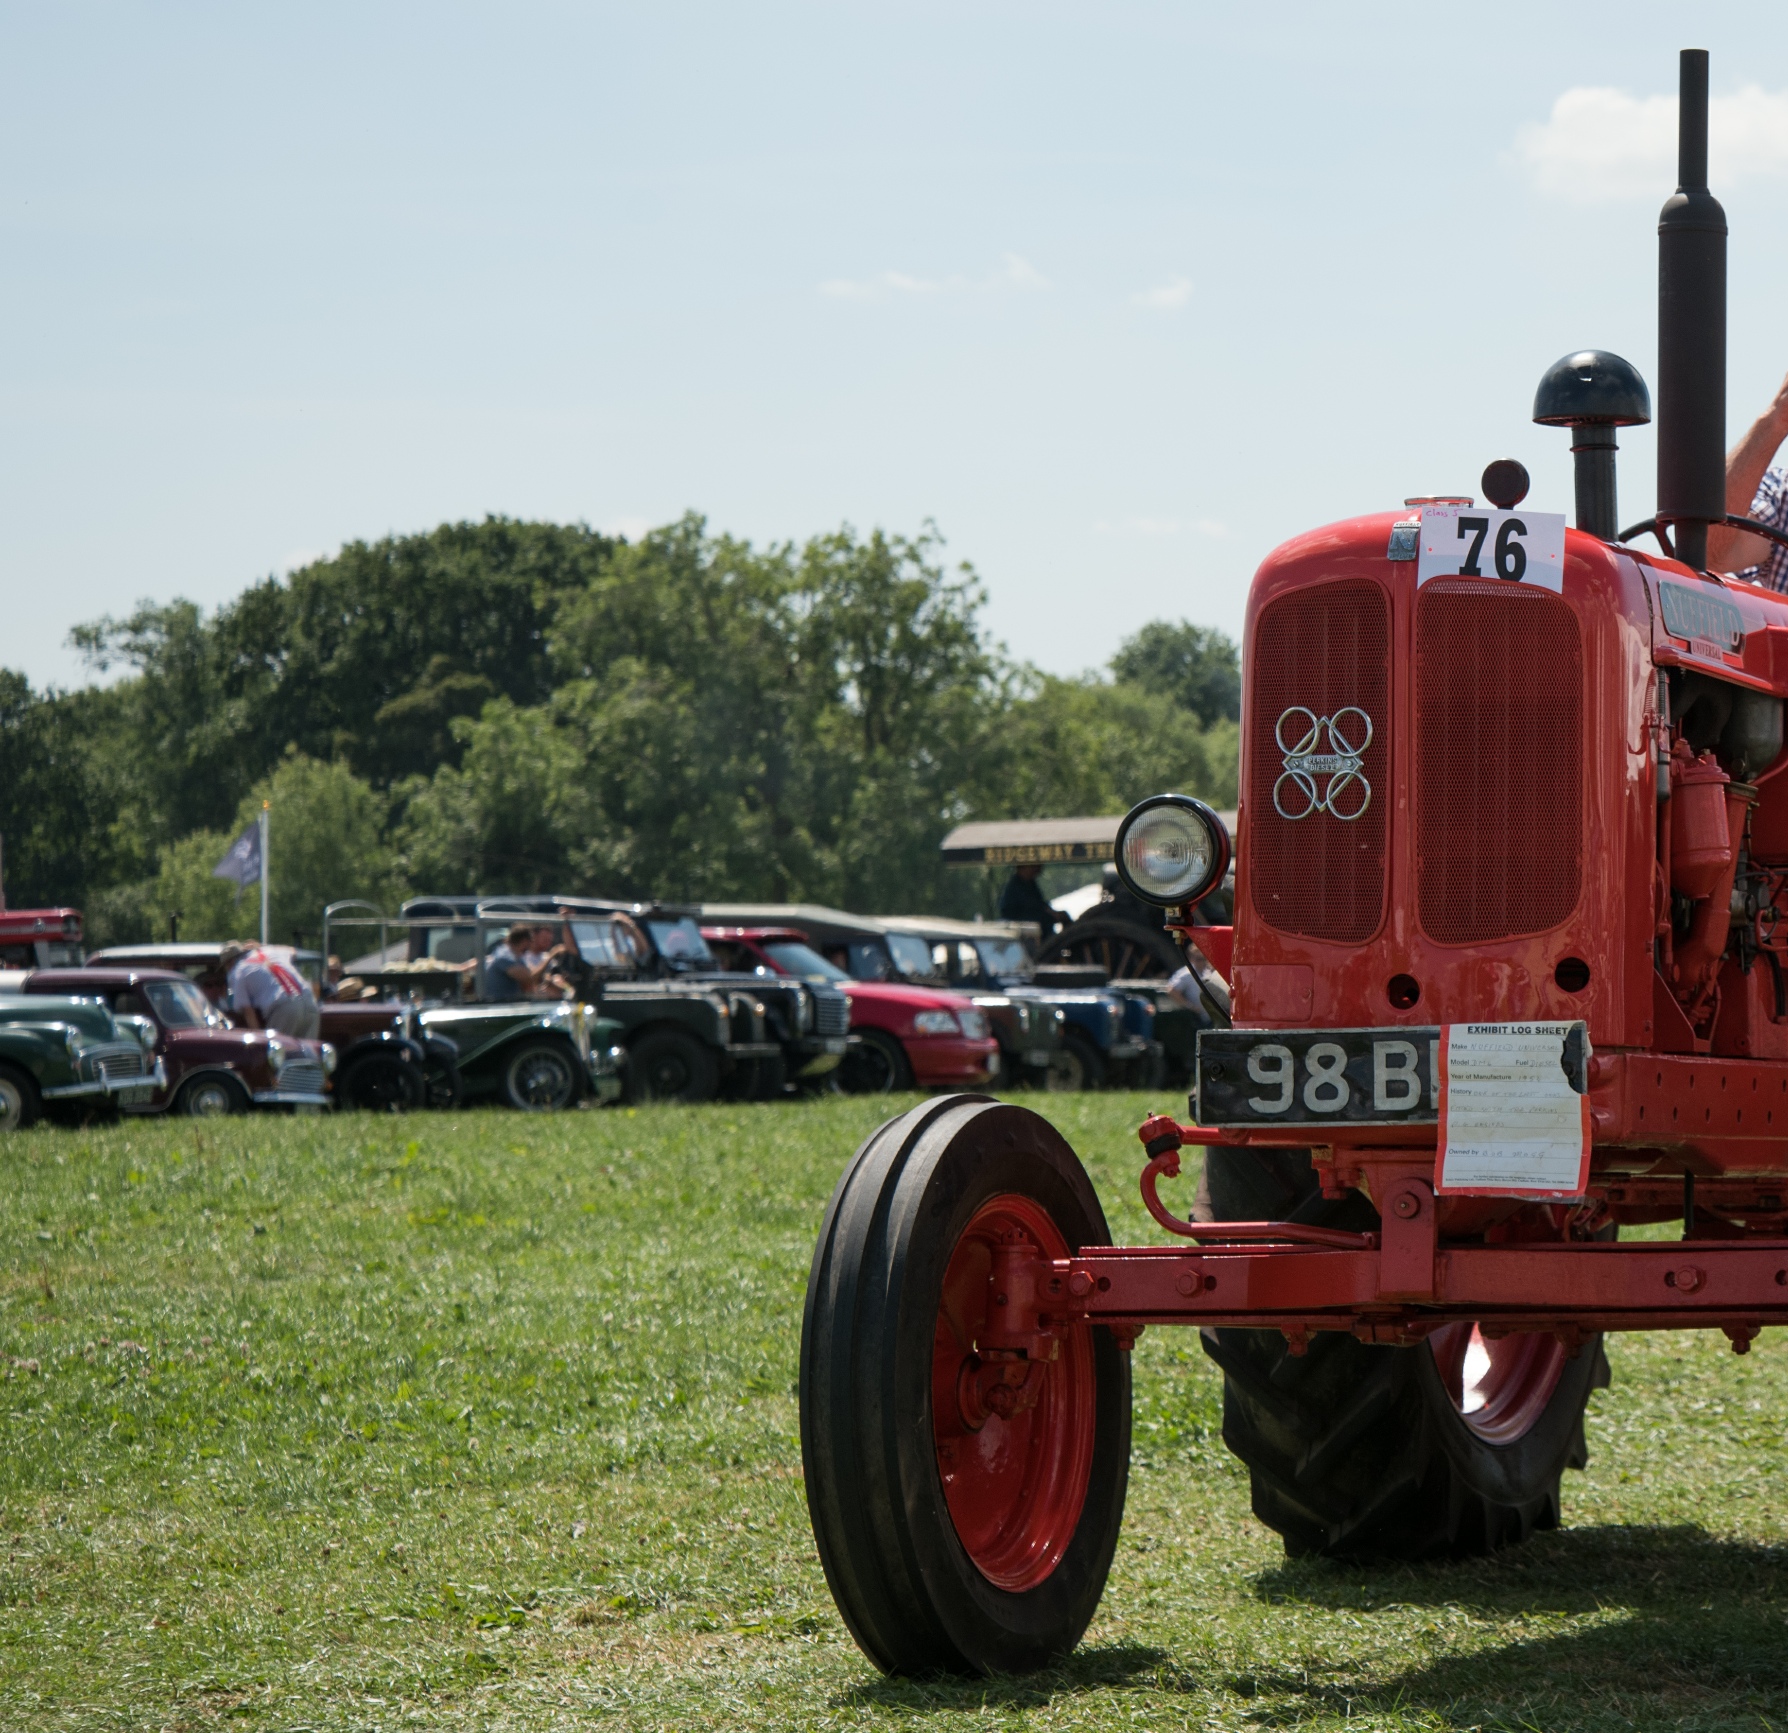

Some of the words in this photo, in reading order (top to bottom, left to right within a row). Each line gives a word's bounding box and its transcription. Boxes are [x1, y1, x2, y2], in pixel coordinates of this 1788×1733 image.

[1425, 509, 1448, 517] Class
[1452, 508, 1463, 517] 5
[1457, 516, 1528, 583] 76
[1665, 585, 1740, 647] NUFFIELD
[1692, 640, 1721, 660] UNIVERSAL
[985, 845, 1074, 863] RIDGEWAY
[1467, 1025, 1508, 1035] EXHIBIT
[1511, 1026, 1532, 1035] LOG
[1535, 1026, 1568, 1035] SHEET
[1471, 1043, 1513, 1051] NUFFIELD
[1247, 1042, 1350, 1114] 98
[1373, 1040, 1440, 1112] B
[1450, 1088, 1472, 1096] History
